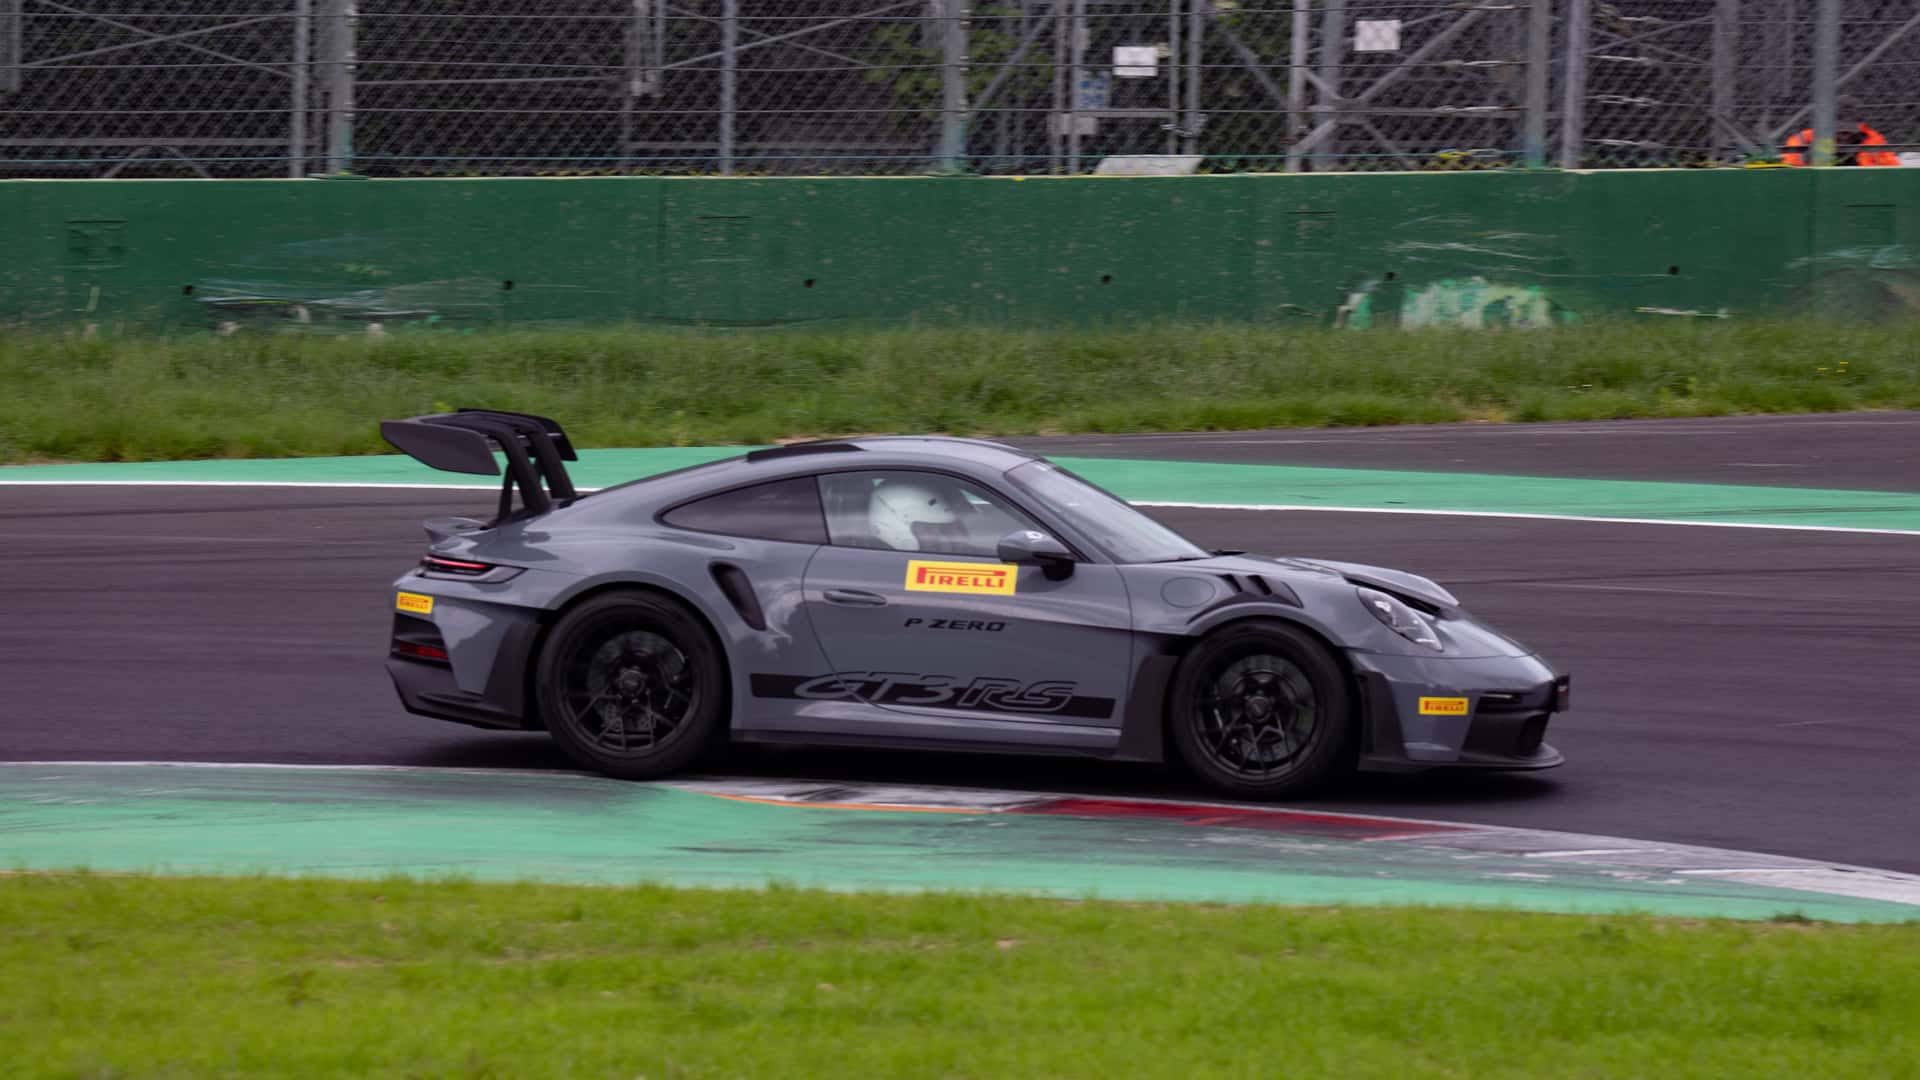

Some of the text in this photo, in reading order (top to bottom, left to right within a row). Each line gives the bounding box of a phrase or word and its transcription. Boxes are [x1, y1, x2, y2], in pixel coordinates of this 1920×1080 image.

[916, 567, 1006, 588] PIRELLI
[904, 618, 1006, 632] P ZERO
